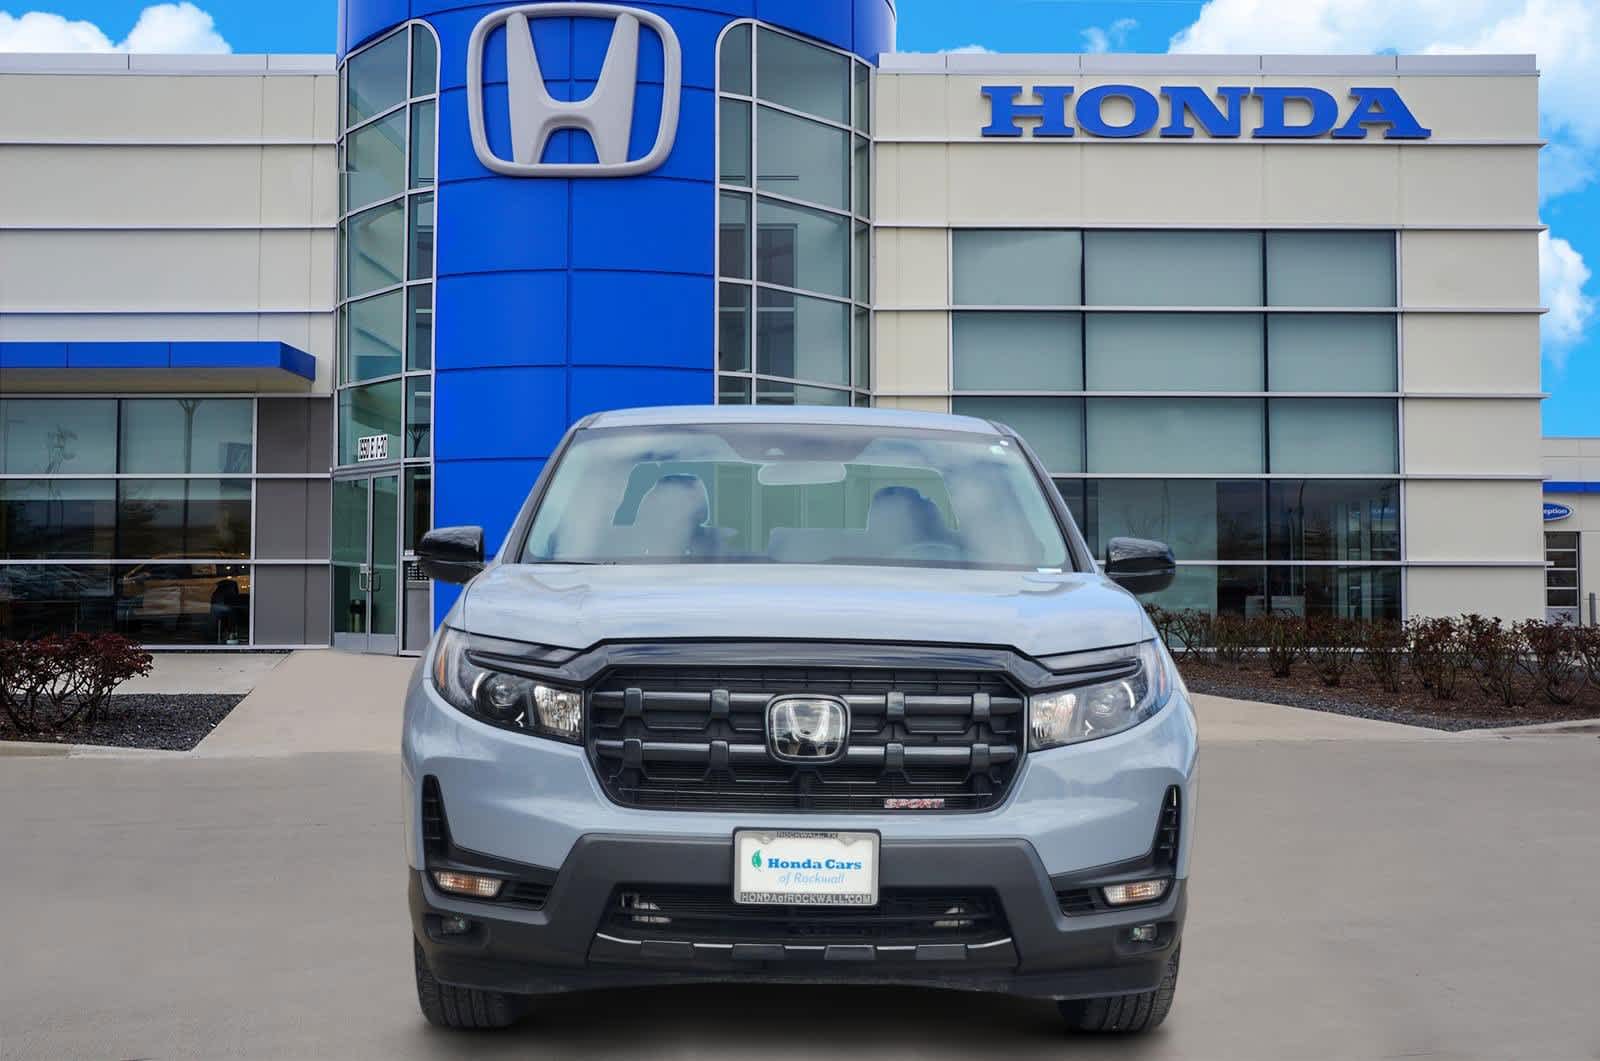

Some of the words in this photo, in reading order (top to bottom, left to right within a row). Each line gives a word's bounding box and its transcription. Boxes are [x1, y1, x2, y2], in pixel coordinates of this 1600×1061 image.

[981, 84, 1432, 140] HONDA
[884, 798, 945, 809] SPORT
[767, 858, 822, 869] Honda
[825, 859, 862, 869] Cars
[778, 872, 790, 885] of
[794, 871, 844, 884] Rockwall
